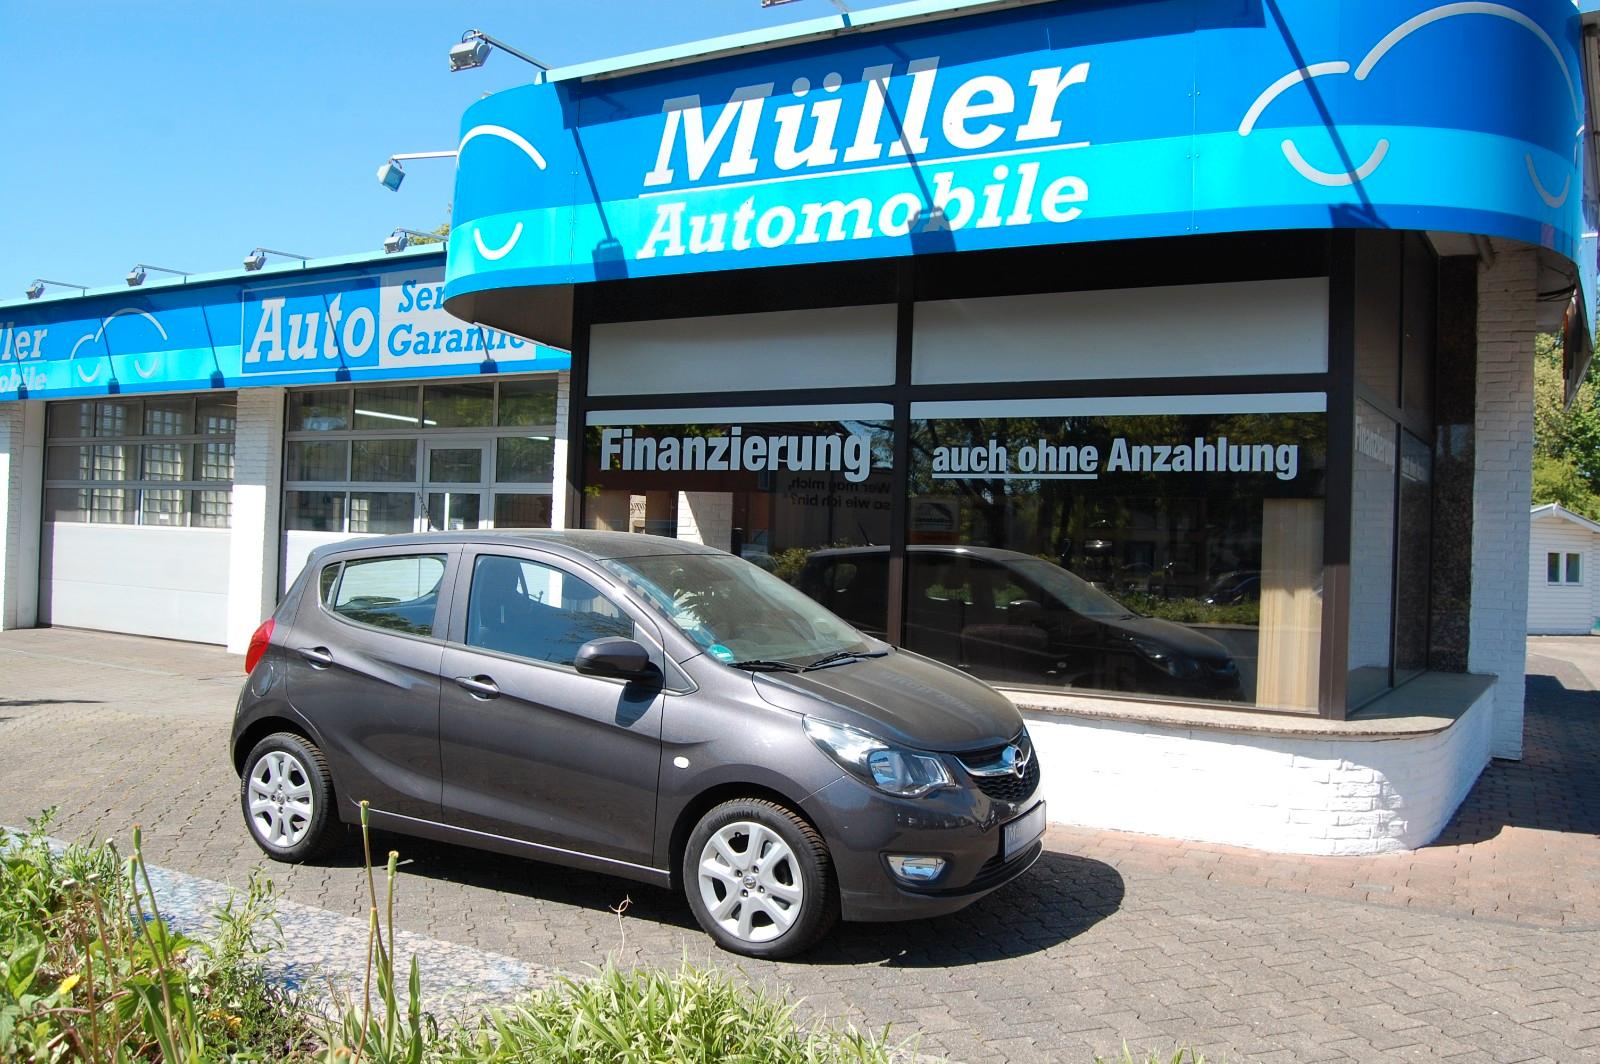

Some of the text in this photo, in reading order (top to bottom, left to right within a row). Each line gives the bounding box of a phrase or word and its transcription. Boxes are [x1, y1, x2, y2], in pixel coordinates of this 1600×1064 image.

[643, 56, 1091, 187] Müller
[636, 161, 1090, 260] Automobile
[245, 292, 376, 363] Auto
[600, 426, 1299, 482] Finanzierung auch ohne Anzahlung
